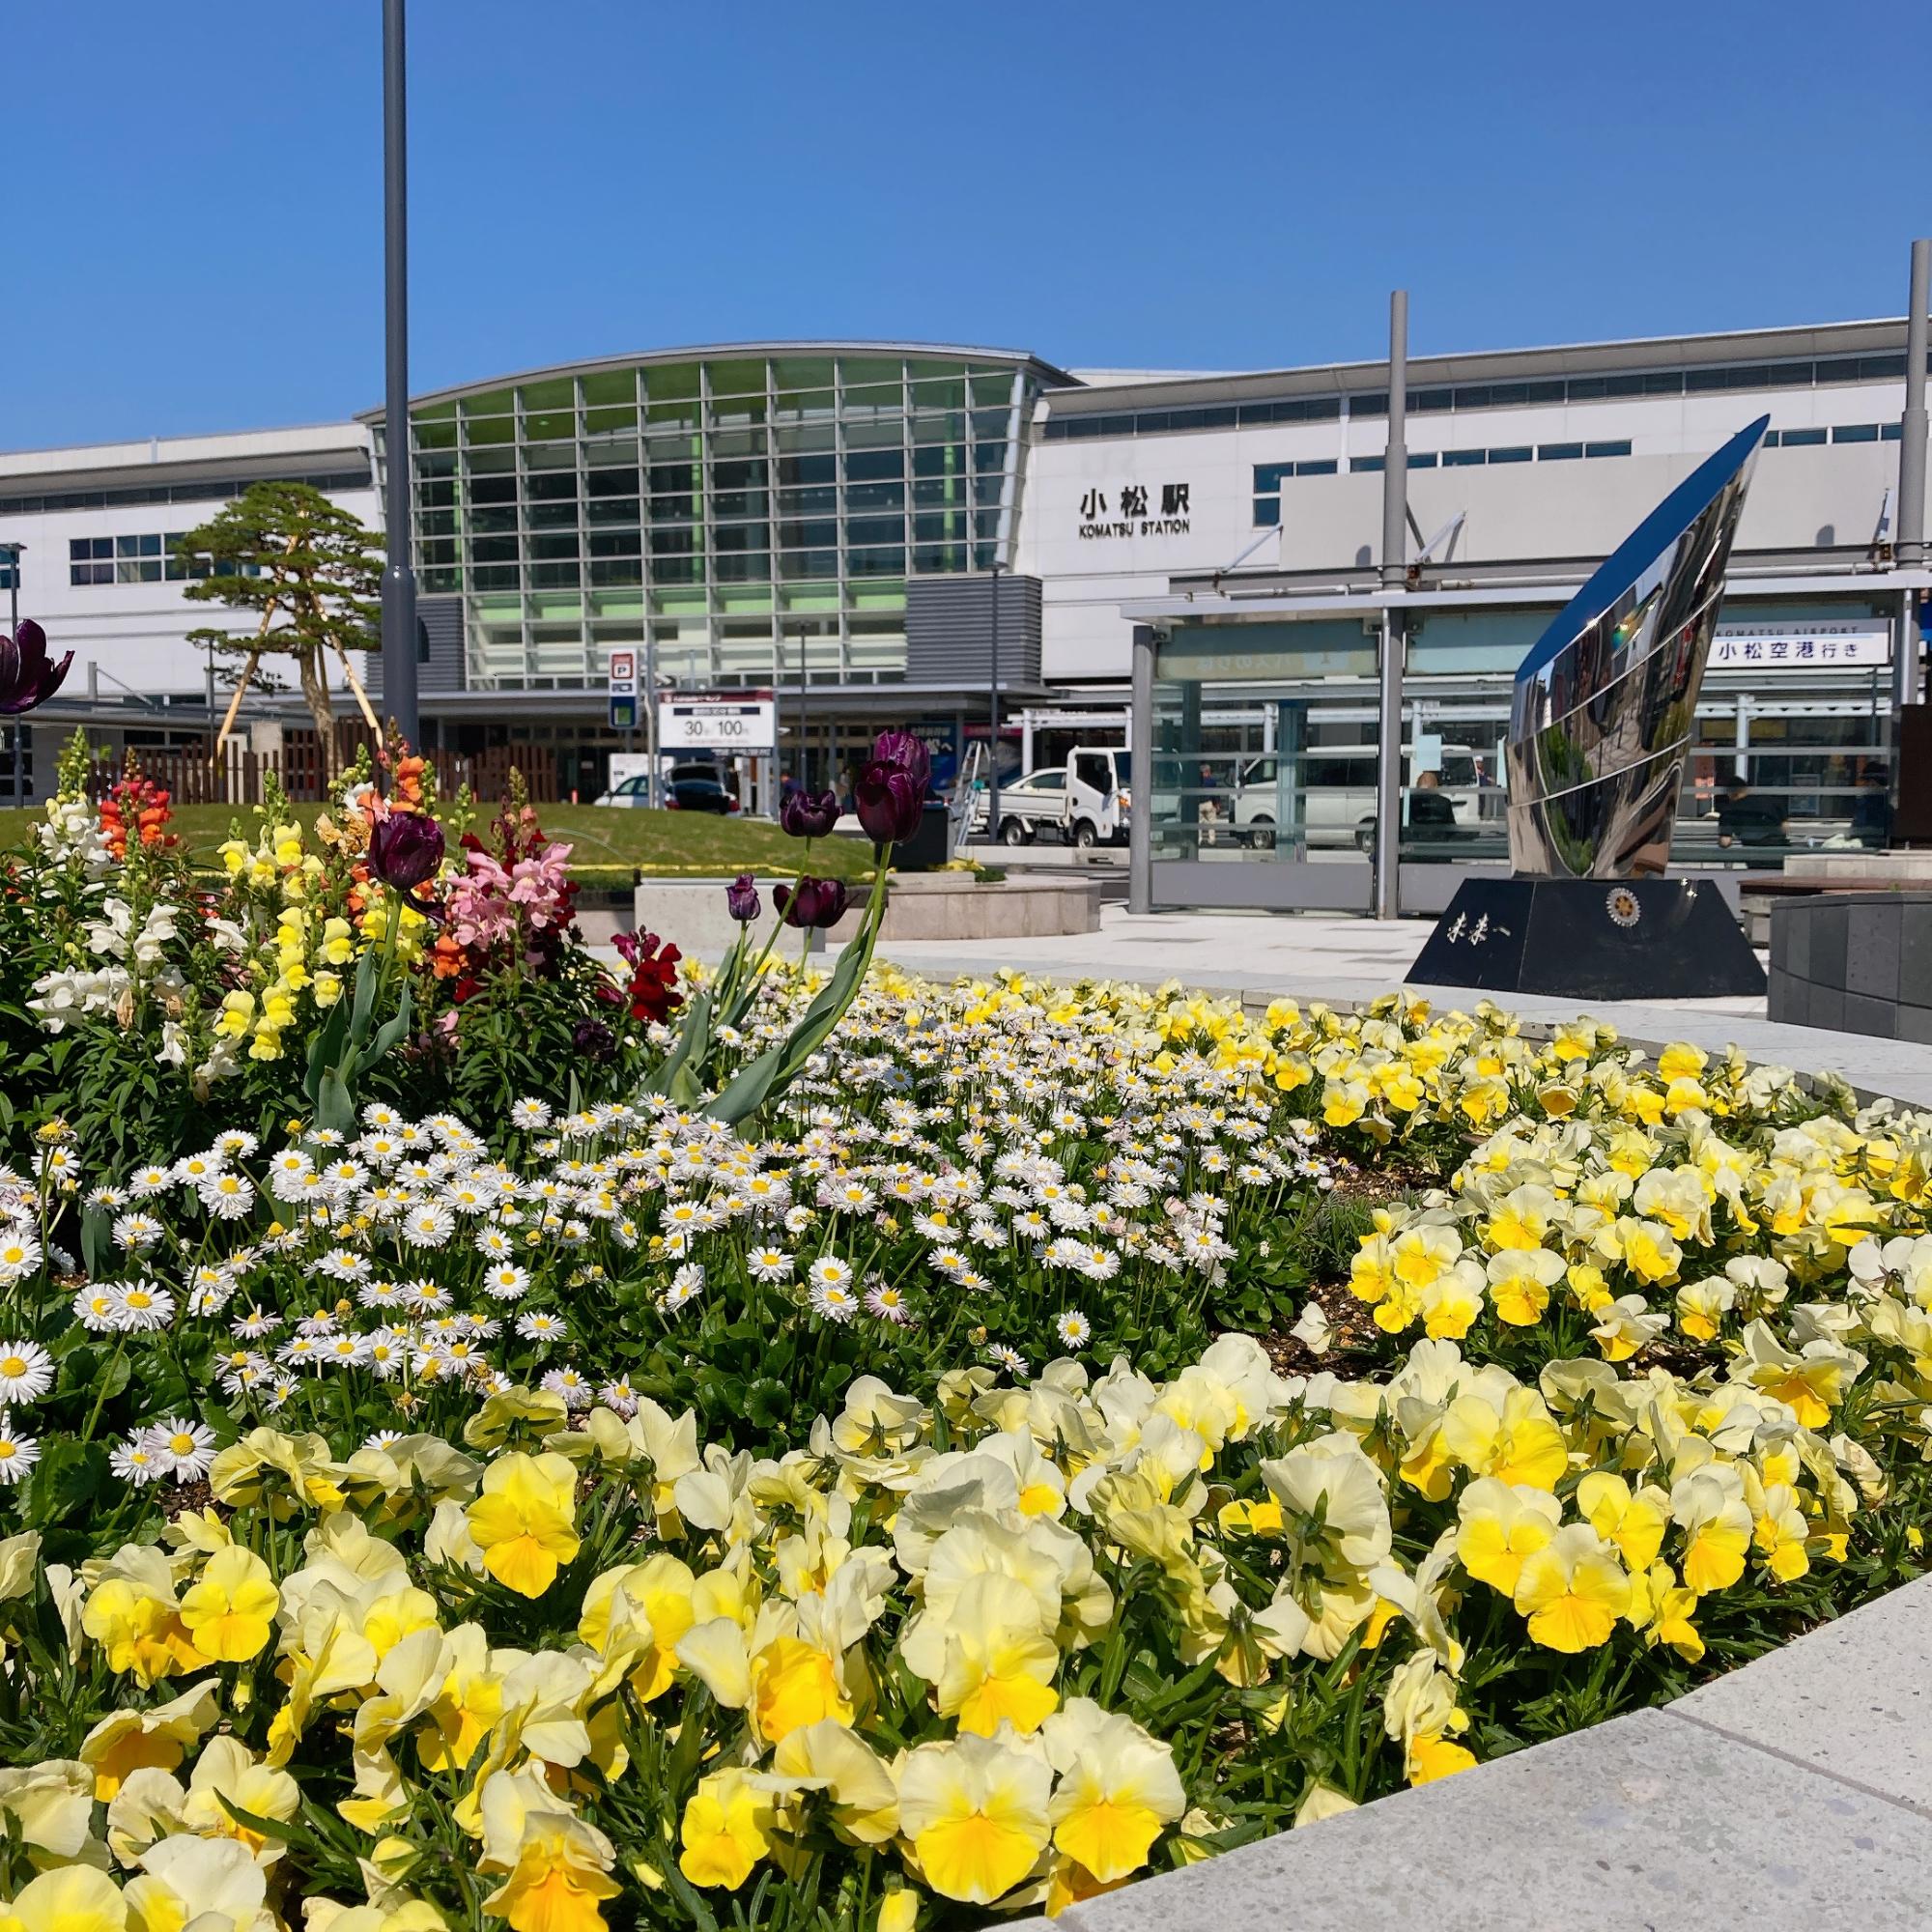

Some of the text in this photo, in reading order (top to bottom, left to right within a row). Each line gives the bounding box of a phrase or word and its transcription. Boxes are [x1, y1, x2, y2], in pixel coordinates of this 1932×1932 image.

[1080, 483, 1189, 521] 小松駅
[1079, 519, 1190, 539] KOMATSU STATION
[1794, 626, 1859, 635] AIRPORT
[1719, 641, 1858, 660] 小松空港行き
